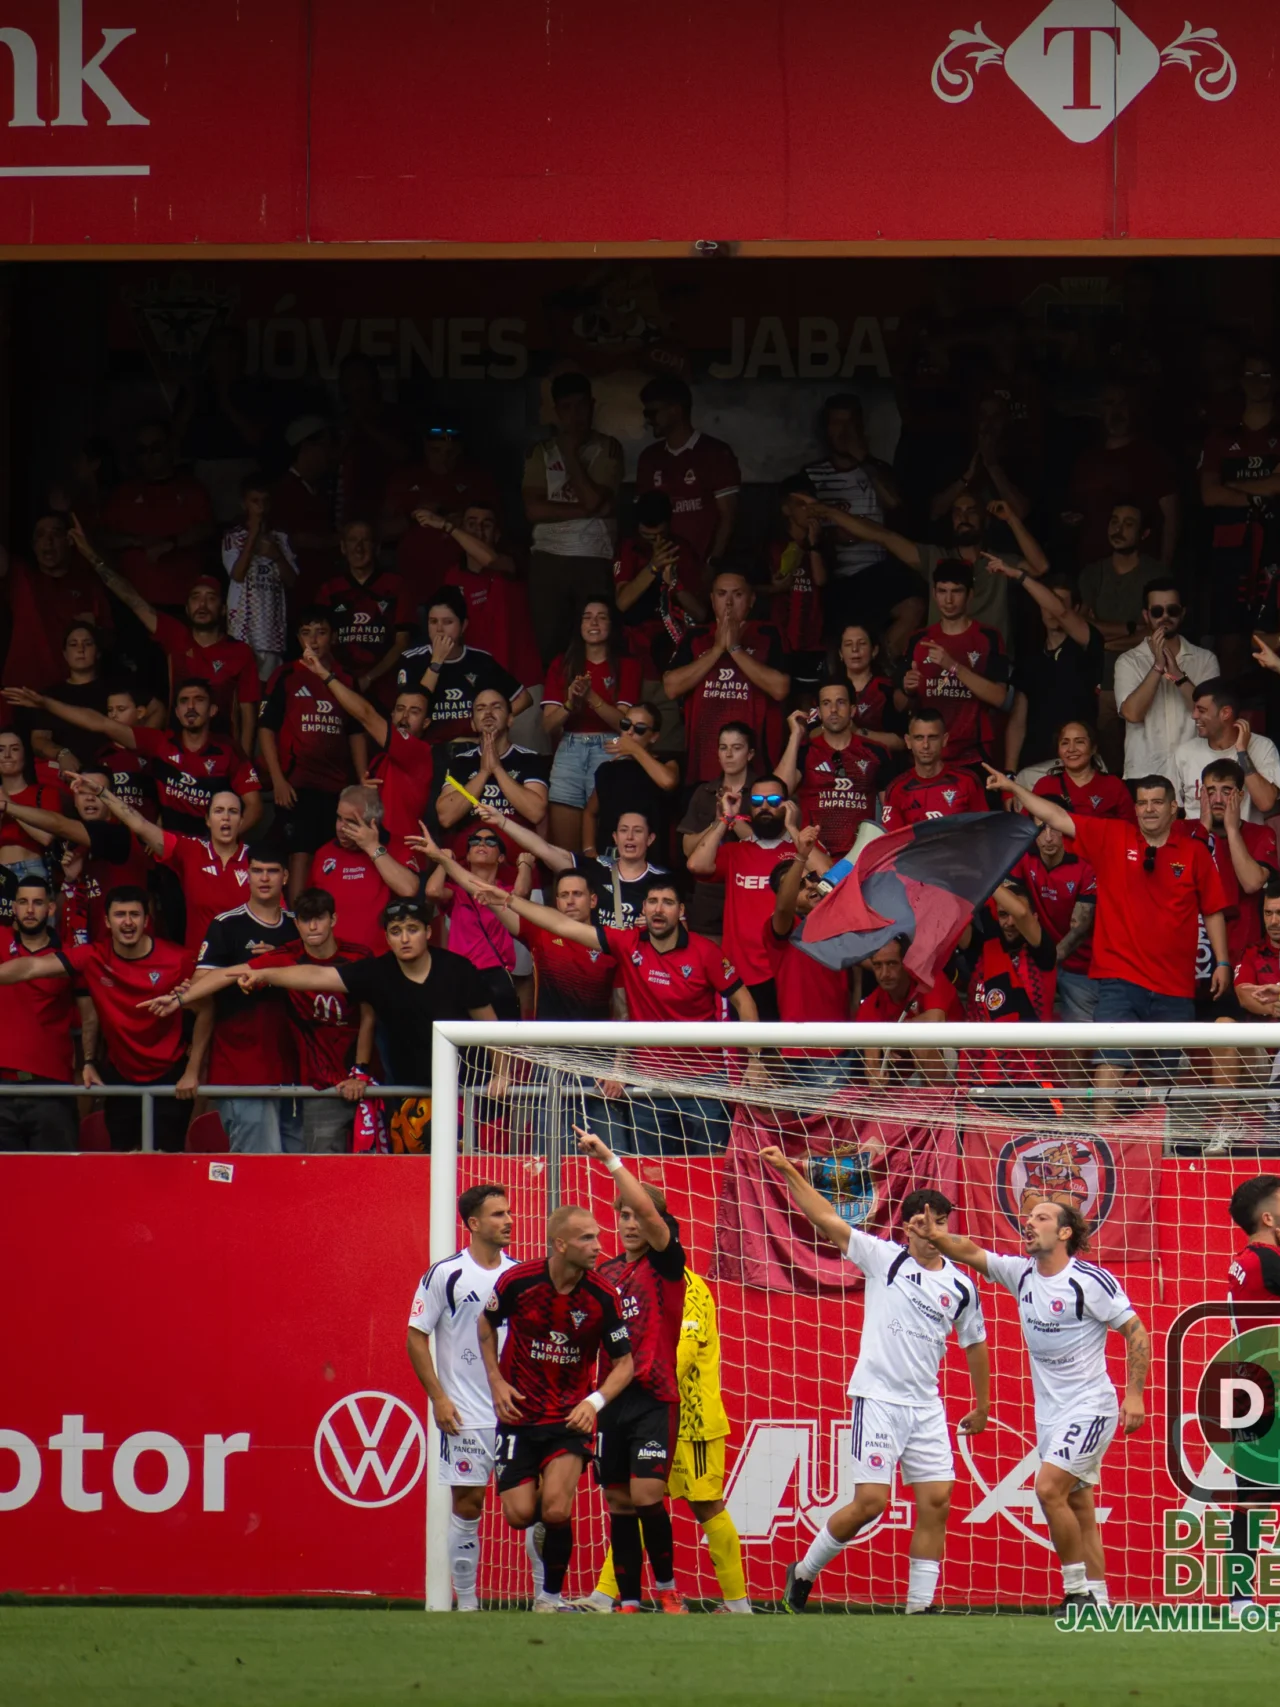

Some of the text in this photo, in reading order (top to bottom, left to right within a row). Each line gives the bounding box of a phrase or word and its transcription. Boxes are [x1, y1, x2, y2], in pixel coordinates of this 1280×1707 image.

[708, 316, 900, 380] JABA
[705, 680, 749, 691] MIRANDA
[703, 690, 748, 700] EMPRESAS
[819, 791, 867, 801] MIRANDA
[819, 800, 867, 810] EMPRESAS
[1063, 1423, 1081, 1445] 2
[462, 1438, 476, 1446] BAR
[453, 1445, 486, 1455] PANCHITO
[638, 1448, 666, 1459] Alucoil
